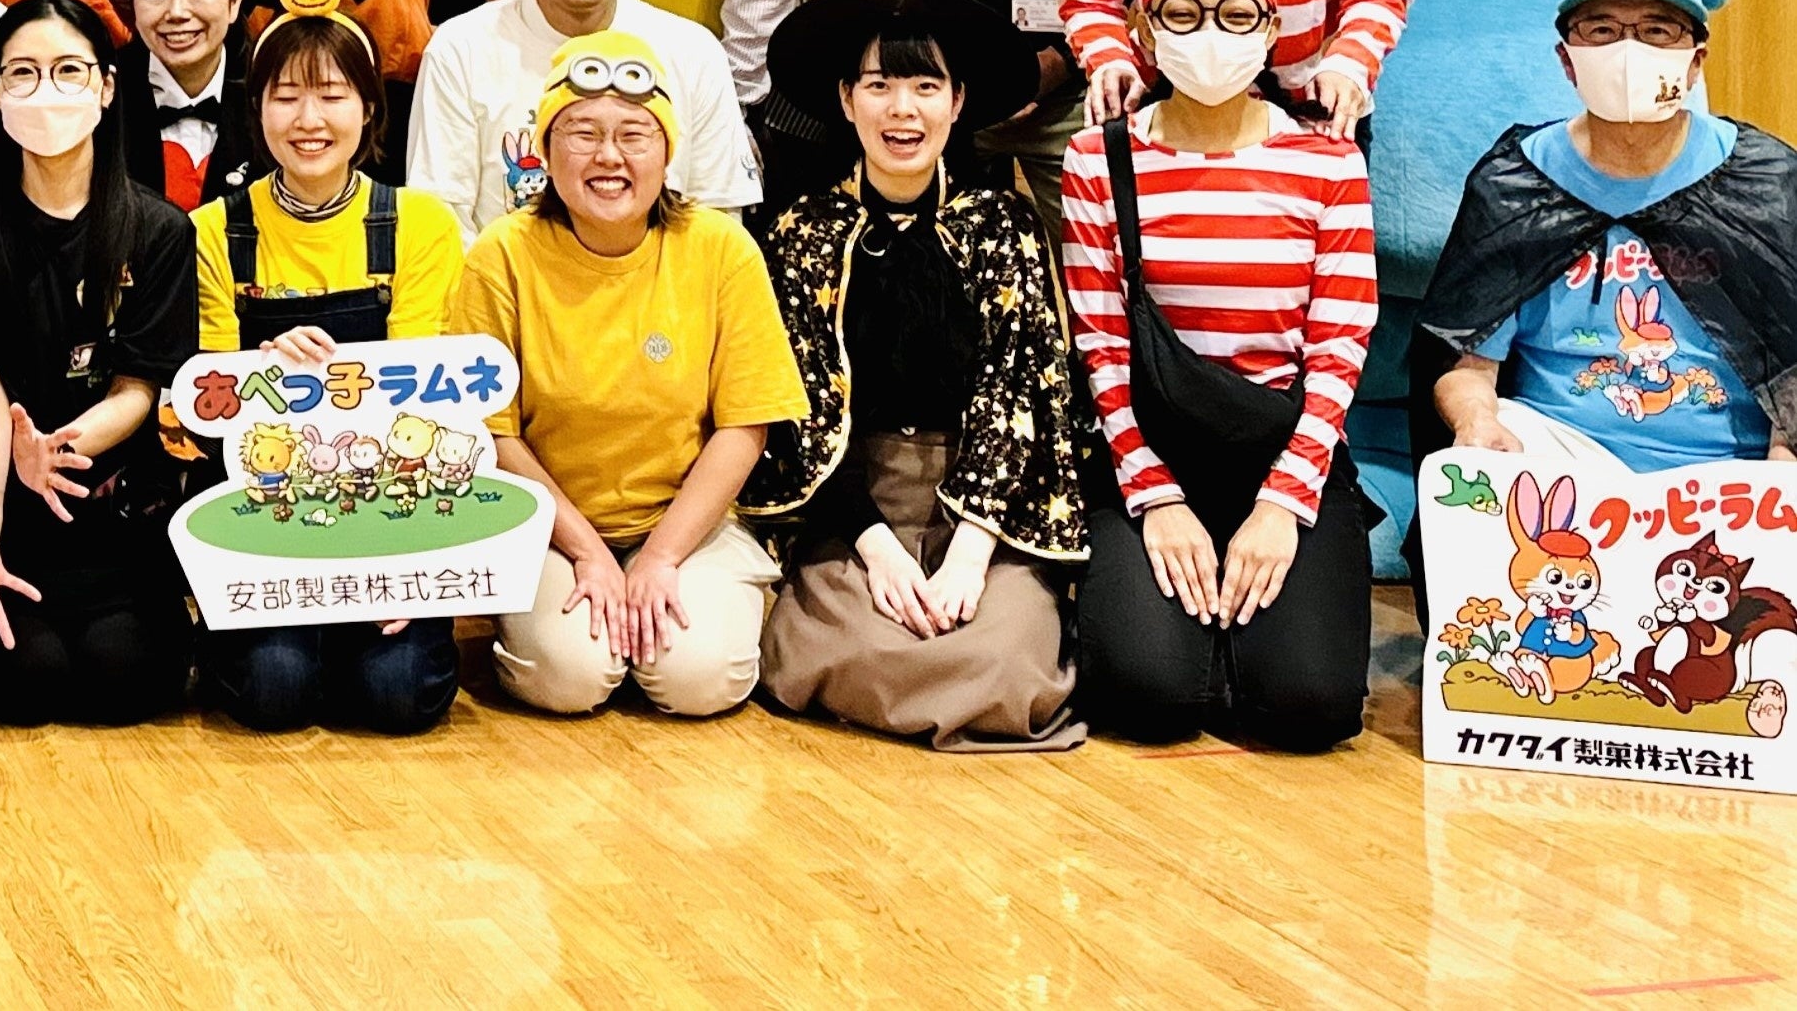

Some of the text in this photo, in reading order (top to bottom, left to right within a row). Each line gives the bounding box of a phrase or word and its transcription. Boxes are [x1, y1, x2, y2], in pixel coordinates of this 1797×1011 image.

[226, 567, 499, 614] 安部製菓株式会社
[1456, 727, 1755, 780] カクダイ製菓株式会社
